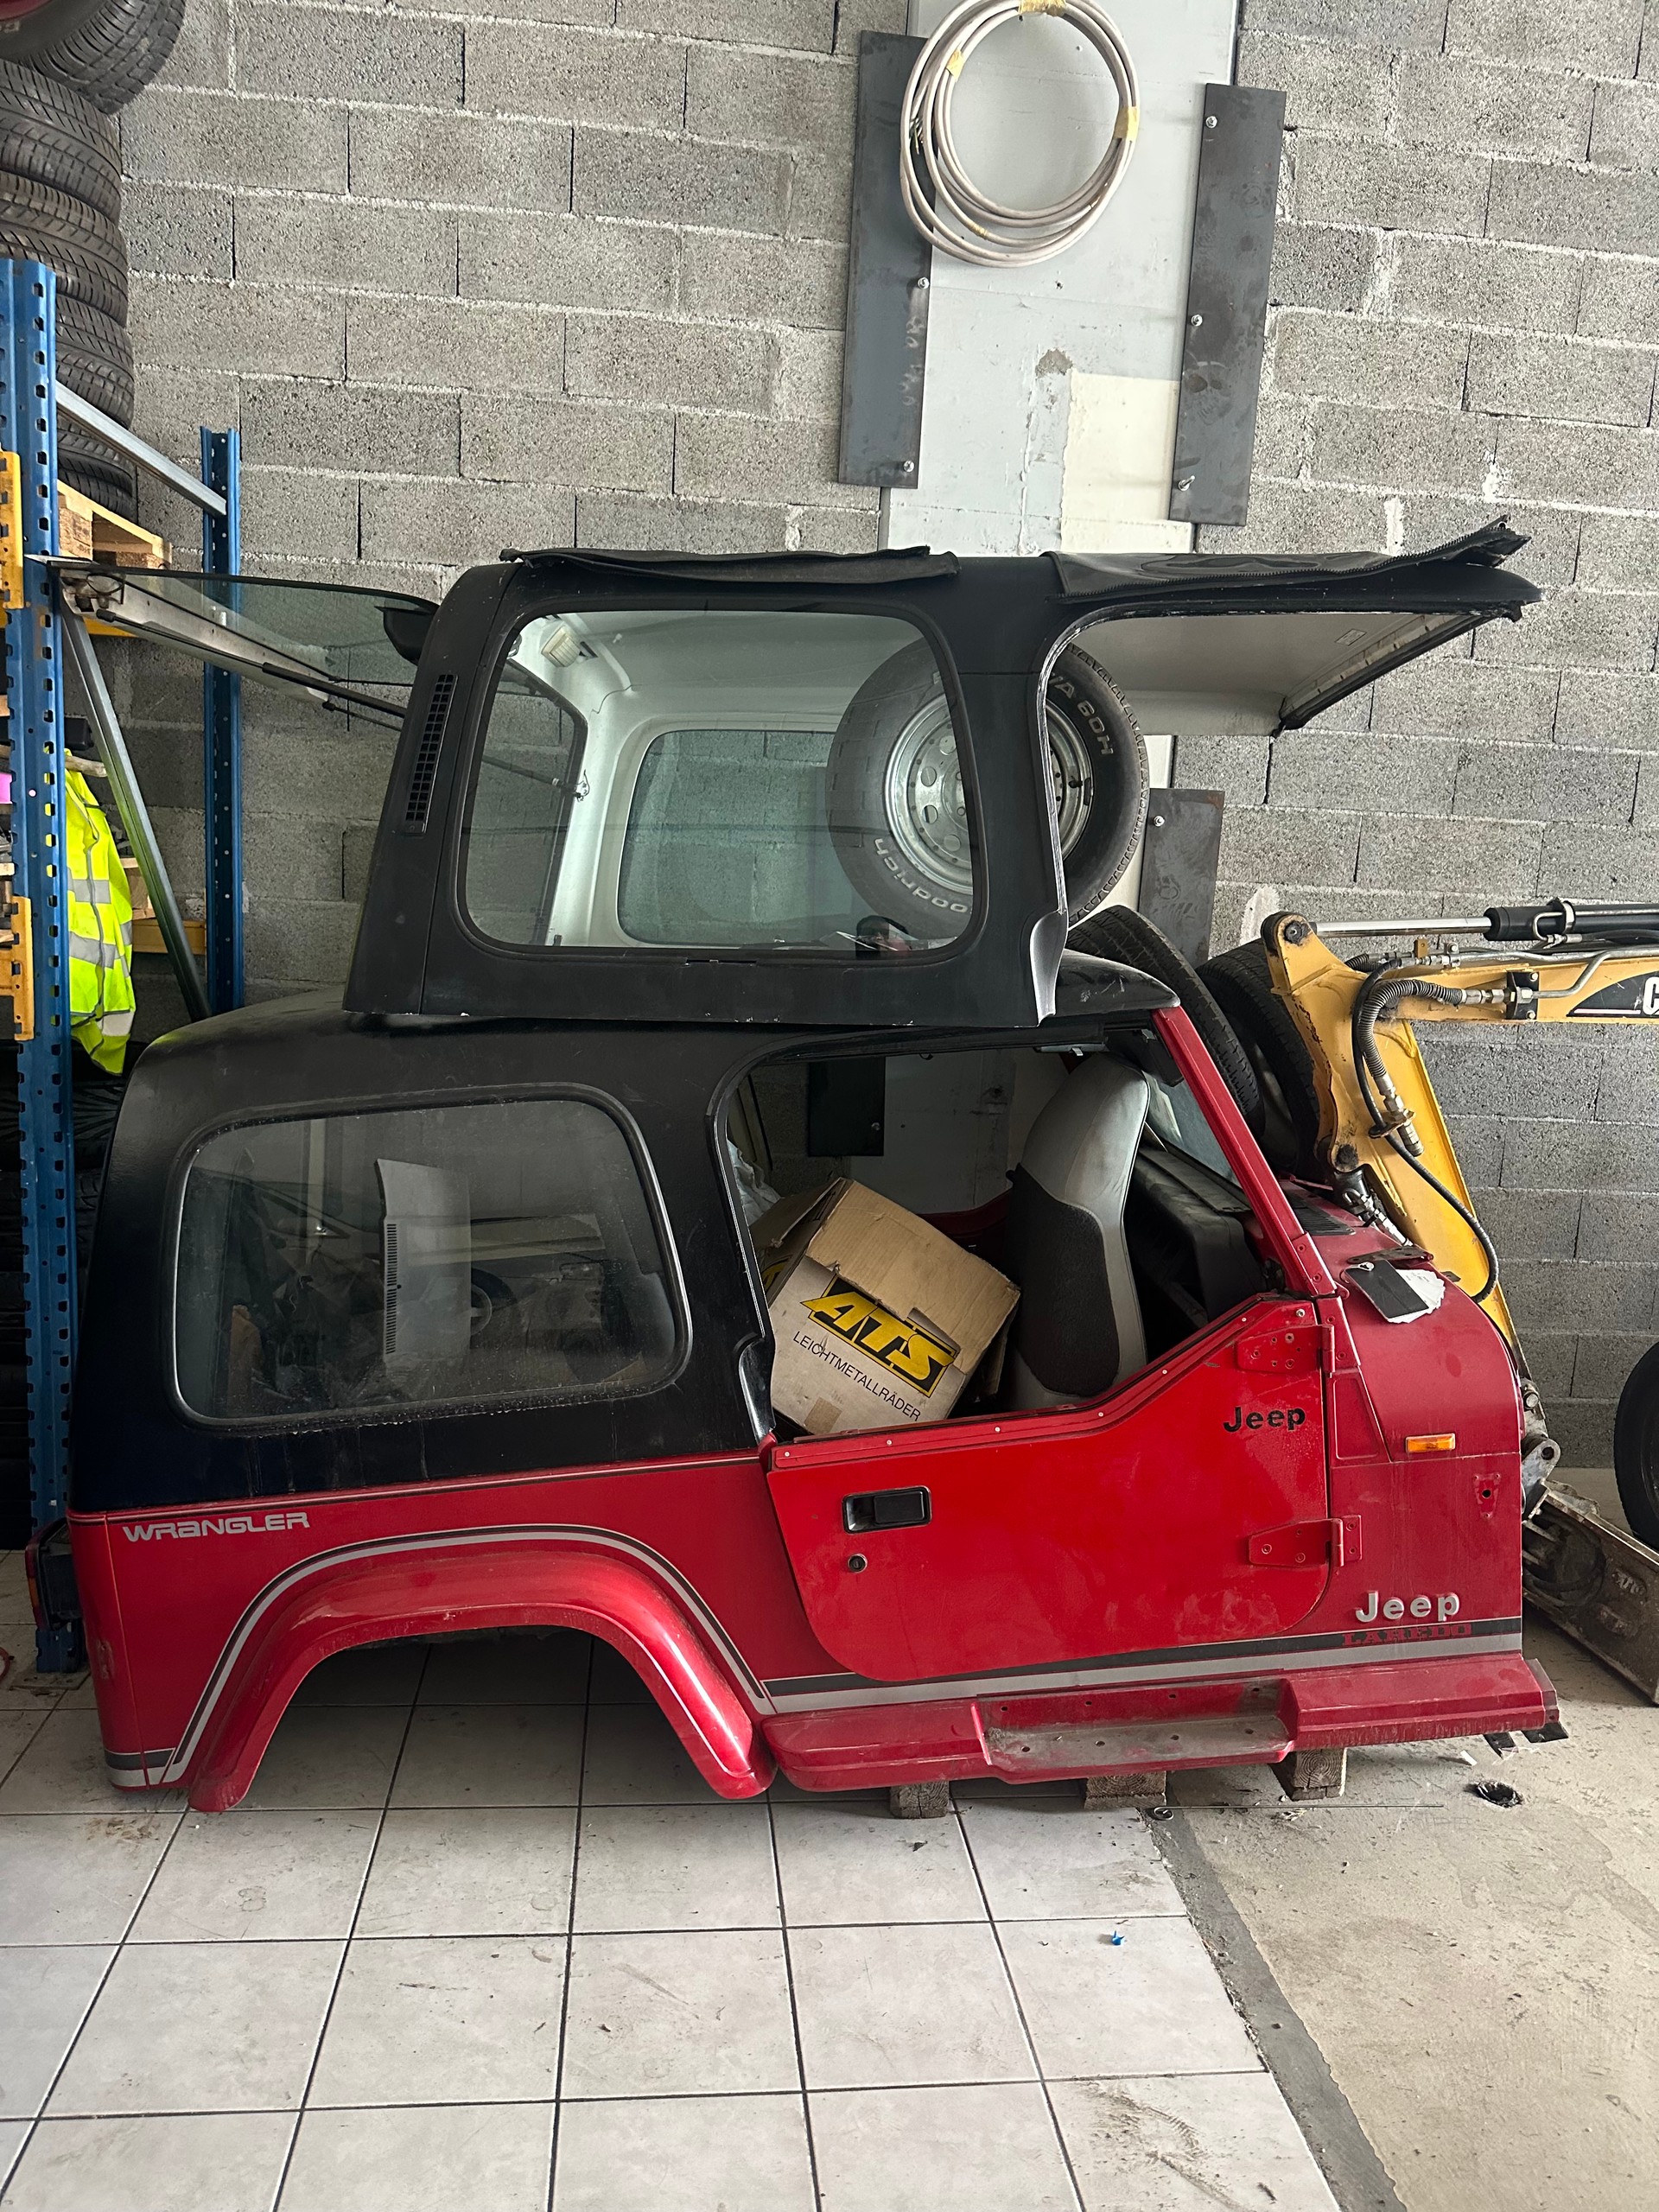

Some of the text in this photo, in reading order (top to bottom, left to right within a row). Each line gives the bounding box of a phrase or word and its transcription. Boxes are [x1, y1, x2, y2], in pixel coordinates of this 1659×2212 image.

[874, 838, 972, 914] oodrich
[799, 1291, 955, 1382] ATS
[792, 1331, 922, 1422] LEICHTMETALLRÄDER
[1223, 1406, 1306, 1433] Jeep
[122, 1512, 310, 1542] WRANGLER
[1354, 1590, 1460, 1623] Jeep
[1343, 1624, 1471, 1646] LAREDO
